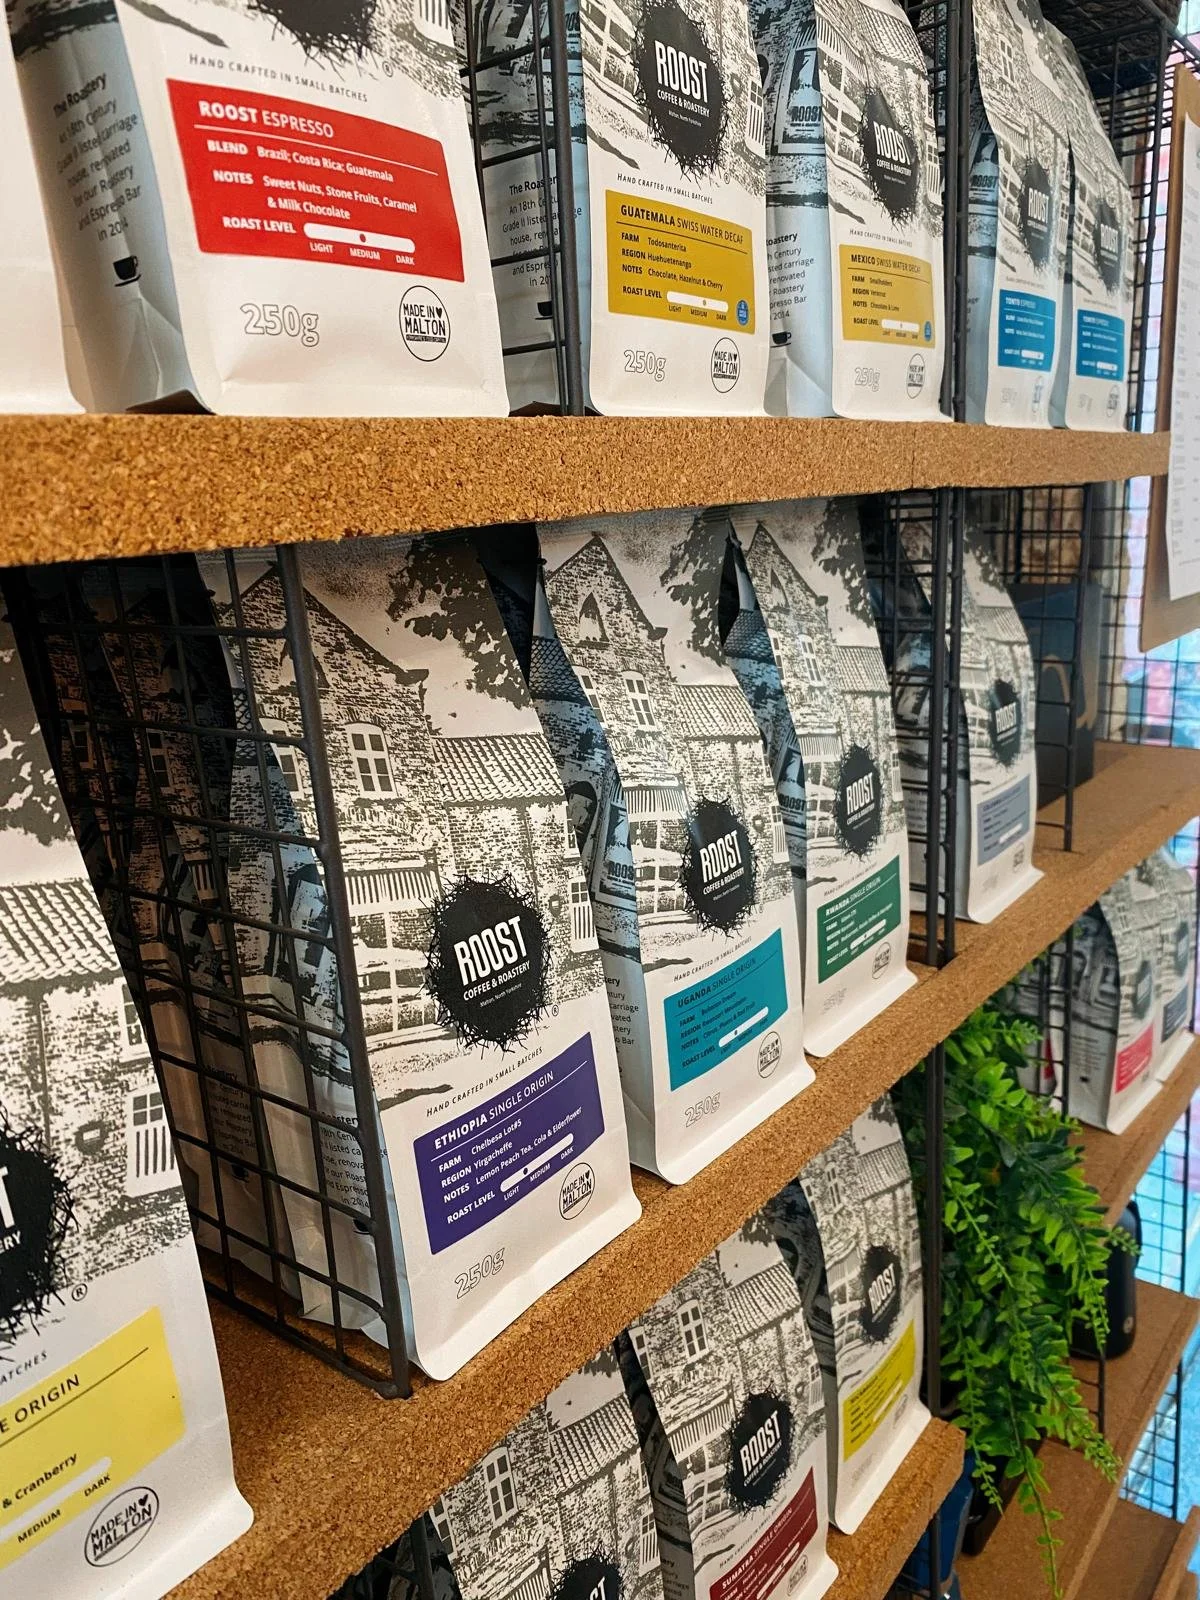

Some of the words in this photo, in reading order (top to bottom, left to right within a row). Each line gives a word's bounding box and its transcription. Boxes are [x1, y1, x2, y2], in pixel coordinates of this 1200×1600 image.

[188, 53, 225, 69] HAND
[228, 61, 278, 80] CRAFTED
[280, 73, 292, 83] IN
[294, 75, 326, 92] SMALL
[328, 84, 369, 103] BATCHES
[654, 39, 708, 103] ROOST
[67, 73, 107, 106] Roastery
[657, 88, 679, 106] COFFEE
[678, 96, 684, 108] &
[683, 98, 711, 118] ROASTERY
[100, 112, 139, 146] carriage
[198, 100, 258, 124] ROOST
[261, 109, 335, 139] ESPRESSO
[872, 119, 911, 166] ROOST
[206, 138, 249, 156] BLEND
[292, 151, 322, 168] Costa
[345, 162, 395, 183] Guatemala
[124, 184, 142, 201] Bar
[212, 169, 255, 185] NOTES
[262, 174, 297, 191] Sweet
[297, 180, 325, 197] Nuts,
[325, 184, 354, 201] Stone
[353, 190, 383, 208] Fruits,
[382, 196, 418, 214] Caramel
[509, 183, 523, 197] The
[617, 172, 638, 186] HAND
[638, 178, 665, 192] CRAFTED
[665, 185, 673, 193] IN
[673, 186, 692, 199] SMALL
[691, 192, 714, 206] BATCHES
[266, 195, 278, 209] &
[277, 197, 303, 213] Milk
[302, 200, 351, 220] Chocolate
[509, 203, 518, 216] An
[518, 199, 537, 213] 18th
[221, 215, 262, 231] ROAST
[263, 219, 297, 234] LEVEL
[502, 222, 520, 234] Grade
[620, 203, 676, 227] GUATEMALA
[676, 217, 700, 233] SWISS
[699, 222, 724, 240] WATER
[723, 230, 745, 246] DECAF
[621, 231, 640, 244] FARM
[309, 241, 334, 254] LIGHT
[349, 247, 381, 261] MEDIUM
[395, 254, 416, 266] DARK
[621, 247, 647, 261] REGION
[647, 250, 693, 271] Huehuetenango
[773, 246, 802, 260] Century
[783, 256, 815, 270] carriage
[850, 253, 876, 266] MEXICO
[875, 256, 893, 269] SWISS
[512, 264, 526, 277] and
[529, 275, 539, 287] in
[621, 263, 643, 276] NOTES
[647, 266, 679, 284] Chocolate,
[678, 272, 703, 287] Hazelnut
[702, 275, 708, 288] &
[706, 278, 724, 293] Cherry
[768, 270, 807, 285] renovated
[851, 275, 866, 284] FARM
[622, 285, 644, 298] ROAST
[643, 287, 663, 300] LEVEL
[772, 283, 805, 297] Roastery
[793, 294, 808, 305] Bar
[852, 287, 870, 297] REGION
[852, 300, 868, 309] NOTES
[239, 302, 321, 348] 250g
[403, 303, 426, 318] MADE
[426, 305, 436, 318] IN
[668, 304, 682, 314] LIGHT
[690, 308, 708, 319] MEDIUM
[853, 317, 868, 326] ROAST
[404, 316, 447, 337] MALTON
[624, 349, 667, 382] 250g
[713, 359, 738, 376] MALTON
[714, 349, 728, 362] MADE
[845, 771, 876, 817] ROOST
[699, 829, 743, 884] ROOST
[702, 879, 721, 896] COFFEE
[453, 915, 528, 987] ROOST
[673, 969, 691, 983] HAND
[690, 958, 714, 975] CRAFTED
[720, 945, 735, 963] SMALL
[463, 983, 492, 1002] COFFEE
[491, 977, 499, 989] &
[497, 959, 531, 986] ROASTERY
[676, 986, 713, 1009] UGANDA
[711, 971, 735, 992] SINGLE
[734, 957, 757, 976] ORIGIN
[679, 1014, 696, 1028] FARM
[680, 1023, 702, 1040] REGION
[681, 1037, 700, 1052] NOTES
[758, 1047, 781, 1068] MALTON
[681, 1053, 701, 1069] ROAST
[426, 1099, 451, 1118] HAND
[451, 1083, 485, 1105] CRAFTED
[485, 1077, 494, 1088] IN
[494, 1064, 517, 1082] SMALL
[516, 1046, 544, 1069] BATCHES
[433, 1113, 489, 1151] ETHIOPIA
[488, 1091, 524, 1121] SINGLE
[523, 1069, 555, 1098] ORIGIN
[684, 1091, 722, 1129] 250g
[438, 1154, 463, 1174] FARM
[470, 1130, 504, 1156] Chelbesa
[440, 1164, 473, 1189] REGION
[473, 1139, 514, 1171] Yirgacheffe
[443, 1181, 471, 1204] NOTES
[475, 1165, 501, 1186] Lemon
[500, 1150, 521, 1171] Peach
[519, 1143, 535, 1158] Tea,
[533, 1132, 548, 1148] Cola
[546, 1127, 554, 1138] &
[552, 1105, 584, 1134] Elderflower
[503, 1184, 521, 1202] LIGHT
[529, 1162, 551, 1183] MEDIUM
[559, 1145, 575, 1161] DARK
[562, 1181, 580, 1200] MADE
[578, 1175, 586, 1188] IN
[446, 1203, 474, 1226] ROAST
[473, 1189, 497, 1210] LEVEL
[562, 1179, 593, 1210] MALTON
[454, 1246, 506, 1301] 250g
[868, 1261, 897, 1315] ROOST
[0, 1350, 49, 1386] ATCHES
[14, 1373, 82, 1427] ORIGIN
[739, 1408, 782, 1478] ROOST
[2, 1499, 13, 1511] &
[15, 1453, 78, 1502] Cranberry
[16, 1507, 62, 1545] MEDIUM
[83, 1473, 112, 1499] DARK
[90, 1513, 125, 1544] MADE
[125, 1501, 139, 1520] IN
[92, 1504, 153, 1557] MALTON
[722, 1554, 754, 1590] SUMATRA
